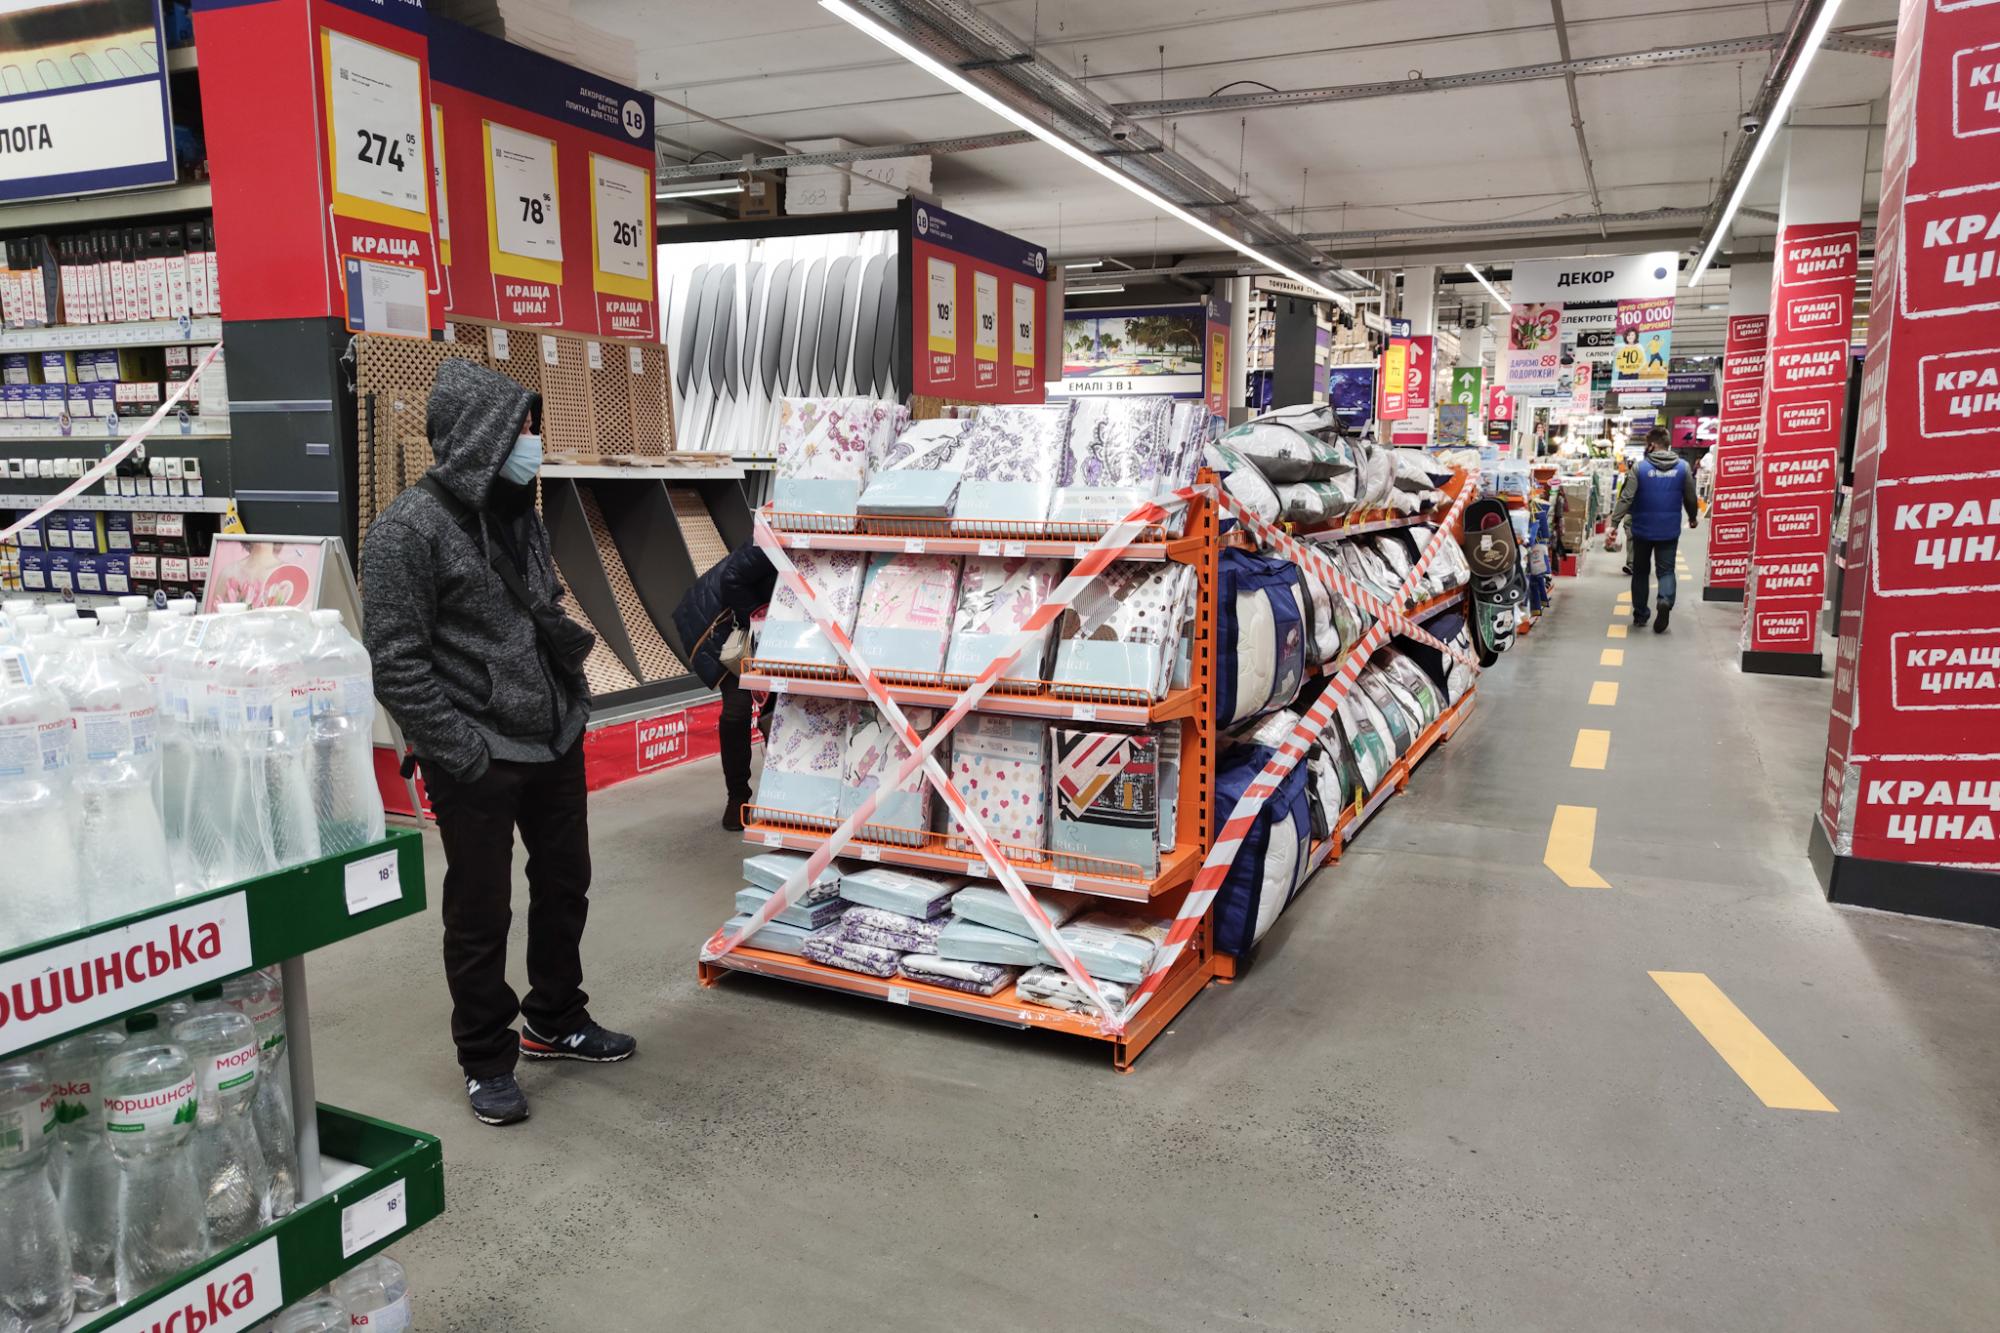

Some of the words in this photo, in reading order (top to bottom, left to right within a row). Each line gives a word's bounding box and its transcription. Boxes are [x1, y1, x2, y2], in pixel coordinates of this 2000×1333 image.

[566, 100, 590, 114] ПЛИТКА
[626, 110, 642, 130] 18
[357, 129, 405, 172] 274
[406, 133, 416, 145] 05
[519, 196, 544, 225] 78
[918, 215, 927, 229] 18
[613, 220, 638, 248] 261
[352, 236, 420, 258] КРАЩА
[1789, 243, 1852, 261] КРАЩА
[1036, 256, 1043, 267] 17
[1796, 258, 1845, 275] ЦІНА!
[1557, 271, 1615, 288] ДЕКОР
[506, 285, 550, 300] КРАЩА
[513, 301, 547, 315] ЦІНА!
[606, 301, 644, 314] КРАЩА
[937, 303, 950, 321] 109
[1794, 302, 1837, 314] КРАЩА
[612, 315, 640, 328] ЦІНА!
[982, 314, 993, 331] 109
[1619, 310, 1642, 326] 100
[1646, 306, 1671, 322] 000
[1799, 311, 1832, 323] ЦІНА!
[1020, 323, 1030, 339] 109
[1737, 322, 1764, 331] КРАЩА
[1740, 328, 1761, 337] ЦІНА!
[932, 355, 951, 365] КРАЩА
[1540, 355, 1557, 367] 88
[1728, 356, 1766, 367] КРАЩА
[1779, 351, 1841, 367] КРАЩА
[1732, 364, 1763, 376] ЦІНА!
[1786, 364, 1834, 381] ЦІНА!
[1068, 382, 1103, 392] ЕМАЛІ
[1127, 381, 1133, 390] 1
[1731, 392, 1758, 401] КРАЩА
[1733, 397, 1756, 406] ЦІНА!
[1783, 407, 1826, 419] КРАЩА
[1721, 422, 1761, 434] КРАЩА
[1788, 416, 1821, 428] ЦІНА!
[1726, 431, 1758, 442] ЦІНА!
[1725, 459, 1752, 468] КРАЩА
[1728, 464, 1750, 473] ЦІНА!
[1768, 458, 1830, 474] КРАЩА
[1775, 472, 1823, 487] ЦІНА!
[1716, 491, 1754, 501] КРАЩА
[1720, 500, 1751, 510] ЦІНА!
[1772, 511, 1815, 523] КРАЩА
[1719, 526, 1746, 534] КРАЩА
[1777, 519, 1810, 532] ЦІНА!
[1722, 532, 1744, 541] ЦІНА!
[1914, 535, 2000, 570] ЦІН
[1711, 558, 1749, 568] КРАЩА
[1758, 563, 1820, 576] КРАЩА
[1714, 566, 1745, 576] ЦІНА!
[1765, 576, 1812, 589] ЦІНА!
[1762, 618, 1804, 629] КРАЩА
[1767, 626, 1800, 636] ЦІНА!
[1920, 671, 2000, 695] ЦІНА
[640, 720, 685, 744] КРАЩА
[645, 737, 680, 760] ЦІНА!
[1886, 814, 2000, 845] ЦІНА
[378, 867, 390, 881] 18
[562, 1033, 586, 1049] N
[387, 1198, 397, 1212] 18
